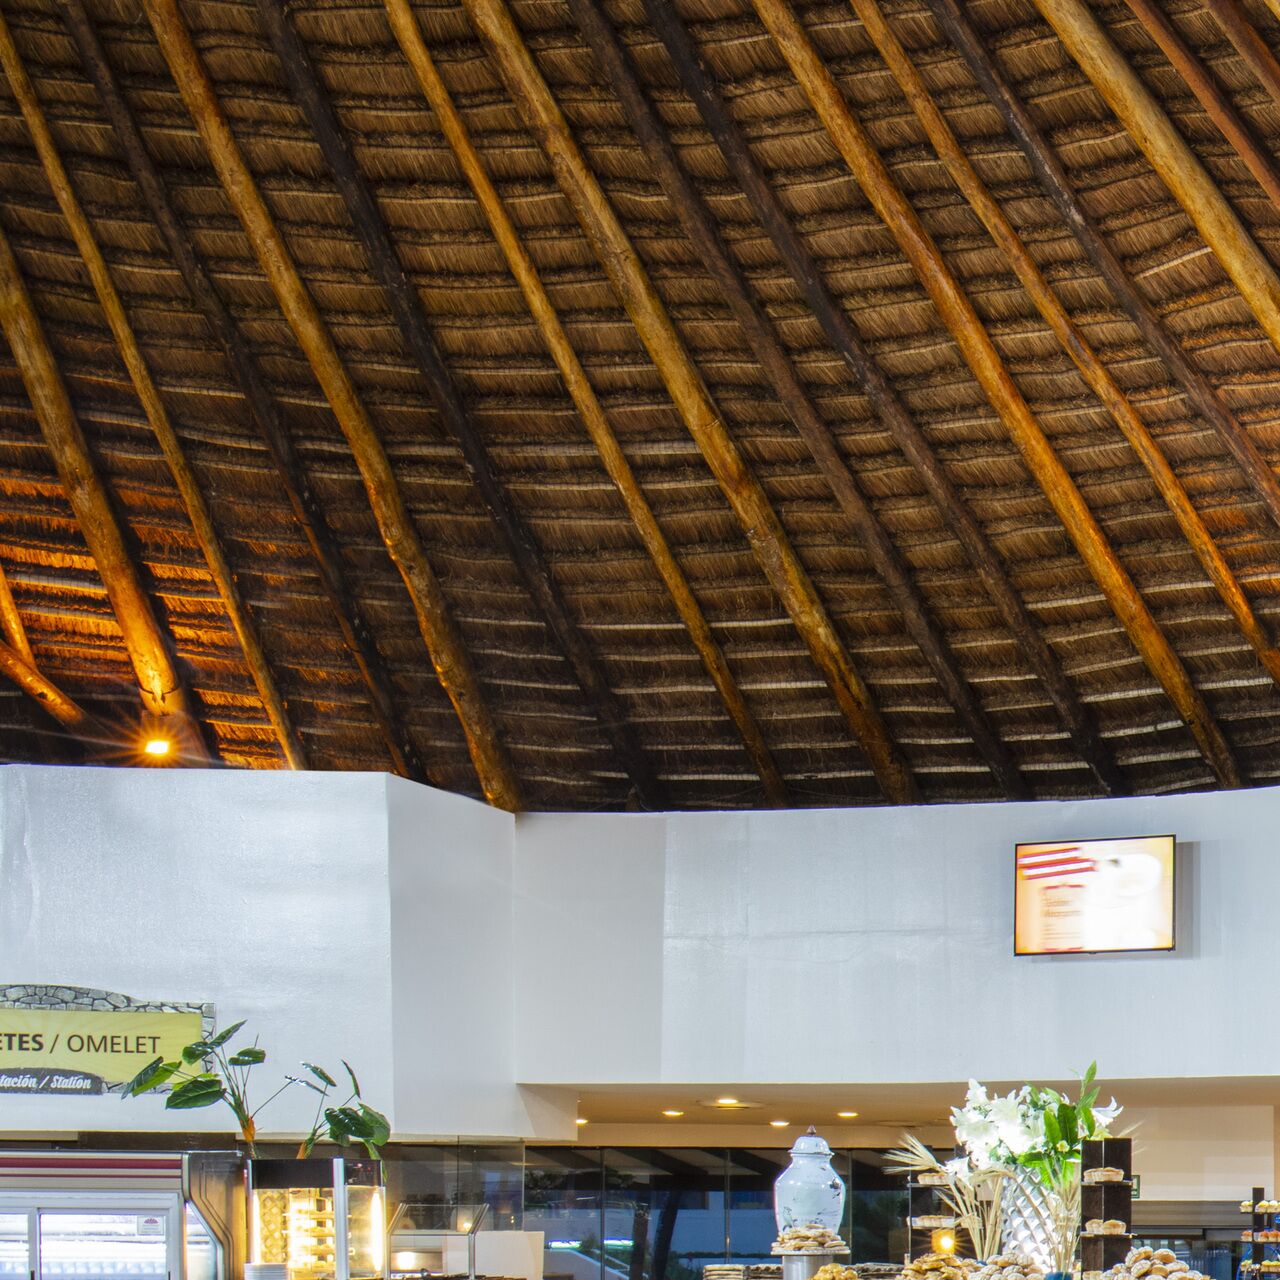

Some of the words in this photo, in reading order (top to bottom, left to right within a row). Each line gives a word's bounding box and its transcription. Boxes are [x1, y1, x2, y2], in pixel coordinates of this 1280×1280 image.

[49, 1034, 60, 1054] /
[67, 1034, 161, 1054] OMELET
[39, 1075, 50, 1089] /
[50, 1075, 92, 1089] Station
